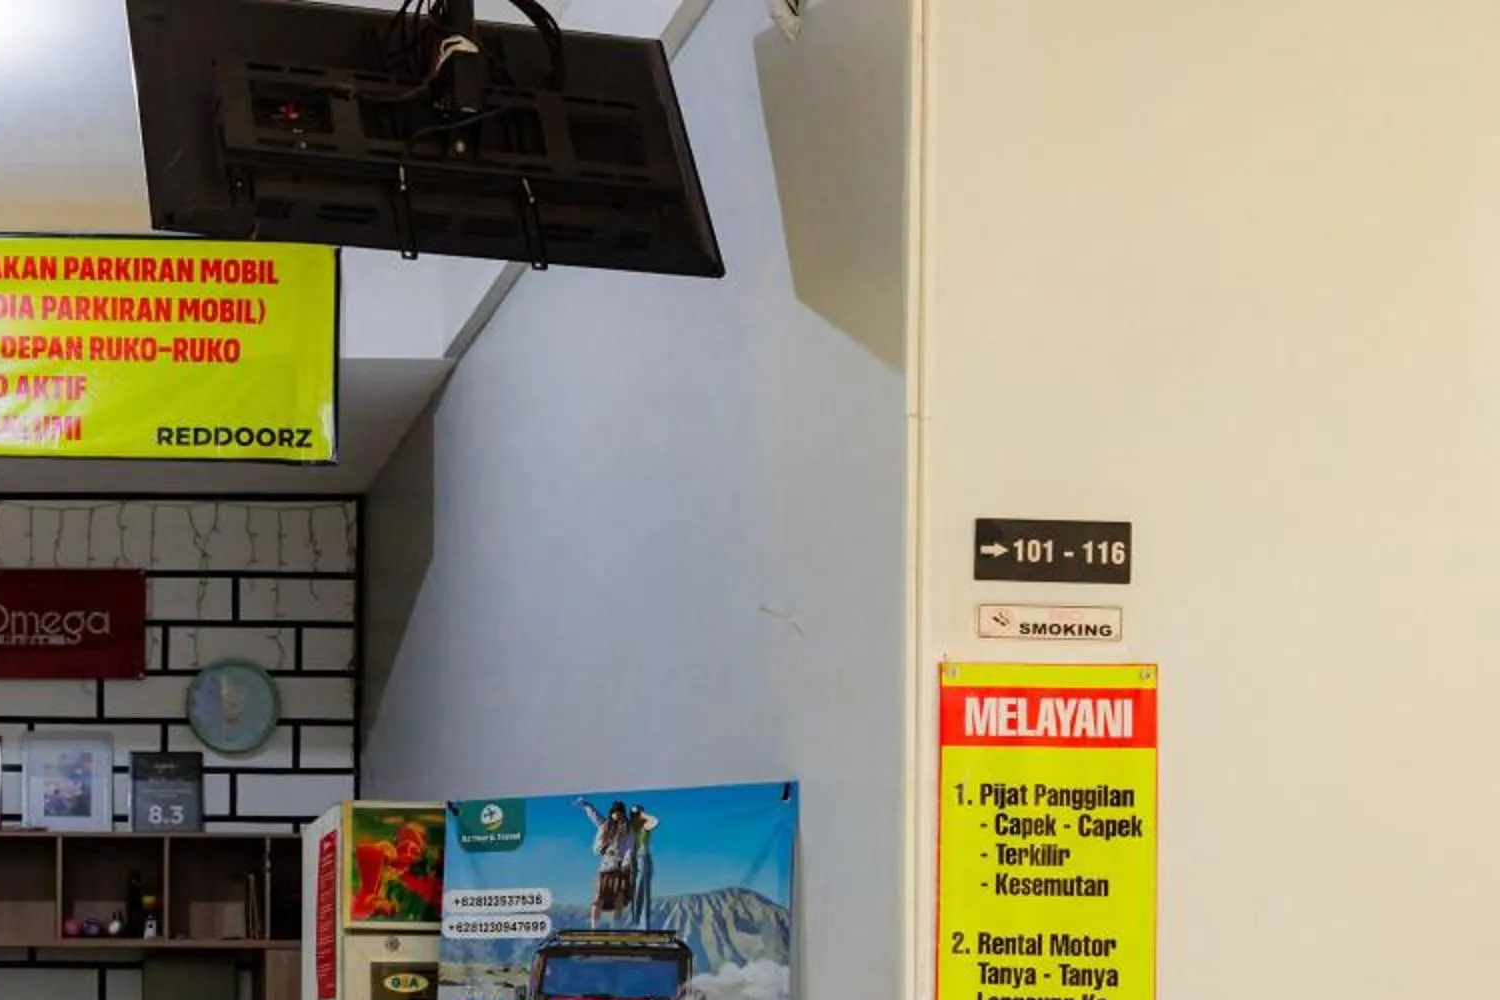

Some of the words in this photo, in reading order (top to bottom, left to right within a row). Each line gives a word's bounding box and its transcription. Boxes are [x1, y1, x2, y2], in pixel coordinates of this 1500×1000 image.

[63, 256, 195, 283] PARKIRAN
[200, 259, 279, 285] MOBIL
[41, 296, 173, 323] PARKIRAN
[178, 298, 268, 326] MOBIL)
[0, 335, 84, 361] DEPAN
[89, 337, 242, 364] RUKO-RUKO
[16, 374, 88, 400] AKTIF
[156, 426, 313, 449] REDDOORZ
[1012, 539, 1054, 563] 101
[1082, 540, 1126, 565] 116
[1018, 622, 1113, 638] SMOKING
[963, 696, 1134, 738] MELAYANI
[953, 784, 973, 806] 1.
[979, 783, 1028, 809] Pijat
[1033, 784, 1135, 810] Panggilan
[147, 804, 185, 826] 8.3
[994, 814, 1057, 839] Capek
[1077, 815, 1143, 841] Capek
[996, 843, 1071, 867] Terkilir
[995, 873, 1110, 897] Kesemutan
[951, 932, 971, 955] 2.
[977, 932, 1043, 957] Rental
[1049, 934, 1117, 958] Motor
[978, 962, 1036, 988] Tanya
[1058, 963, 1119, 990] Tanya
